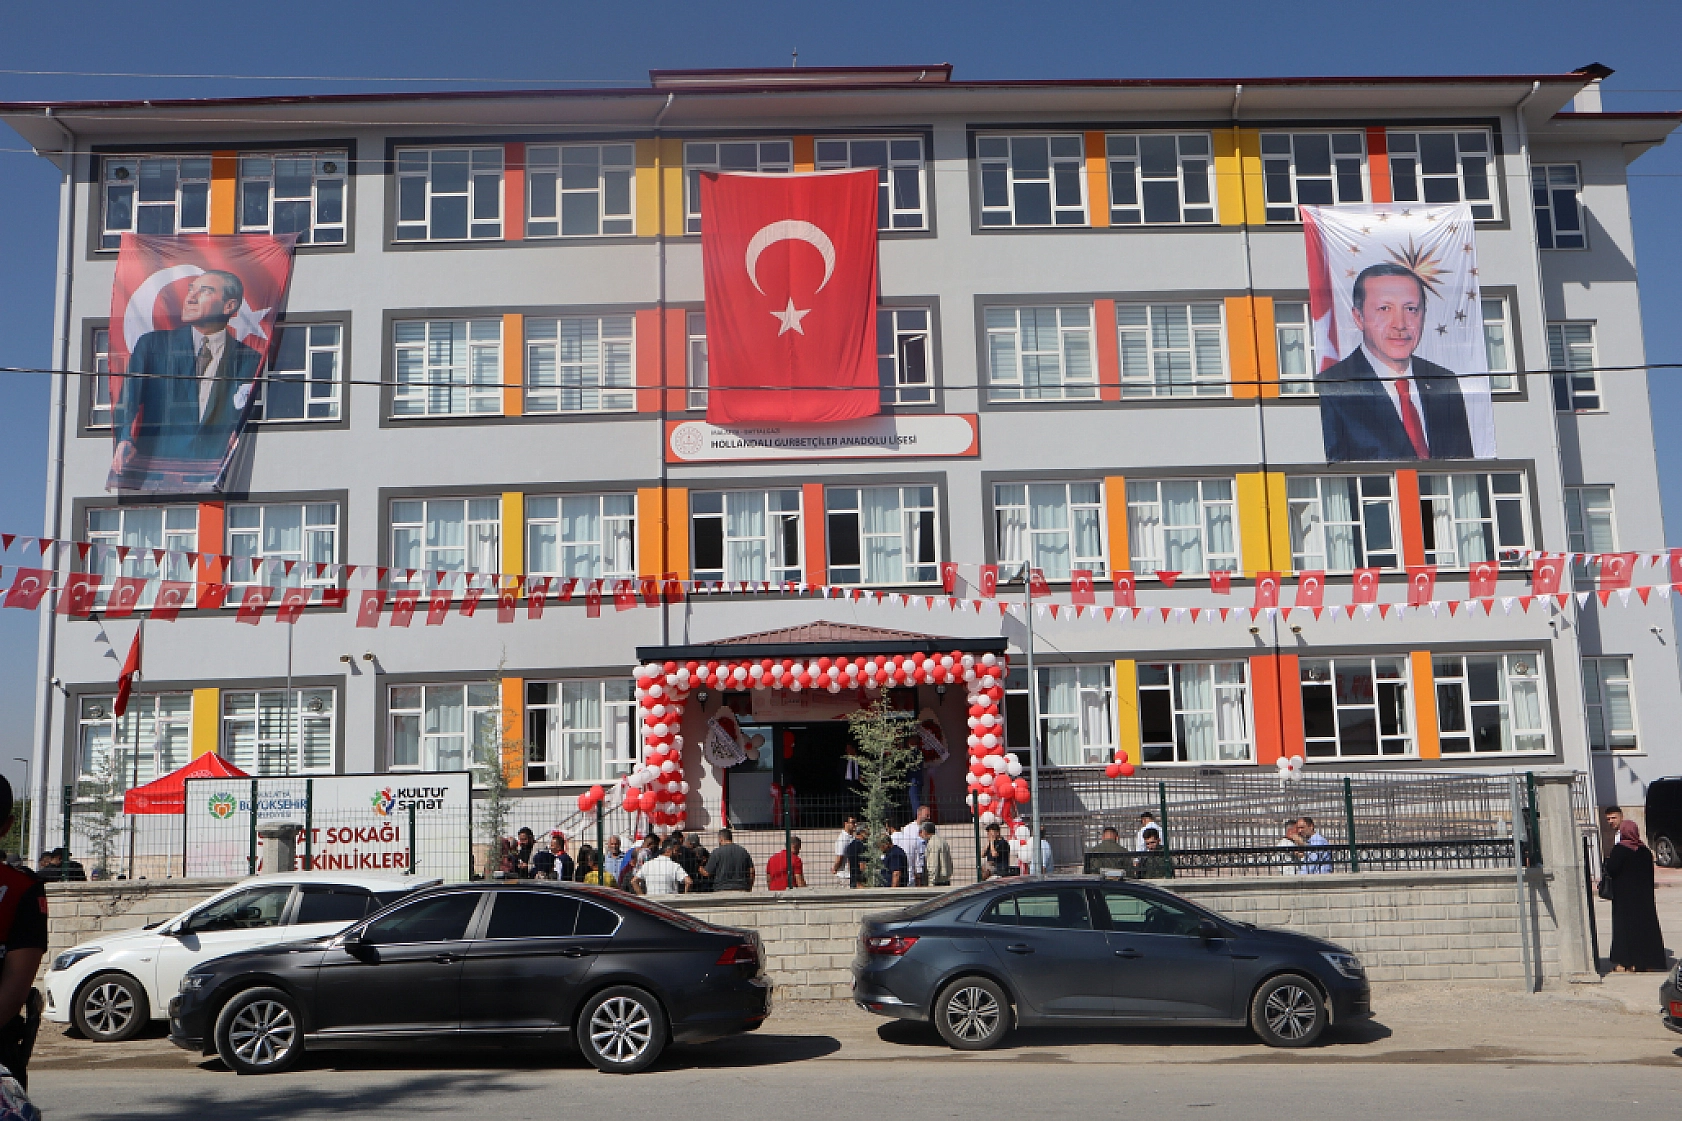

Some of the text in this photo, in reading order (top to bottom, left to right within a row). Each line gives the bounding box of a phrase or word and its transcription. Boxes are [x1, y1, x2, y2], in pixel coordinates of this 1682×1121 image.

[710, 434, 918, 449] HOLLANDALI GURBETÇİLER ANADOLU LİSESİ
[326, 821, 399, 844] SOKAĞI
